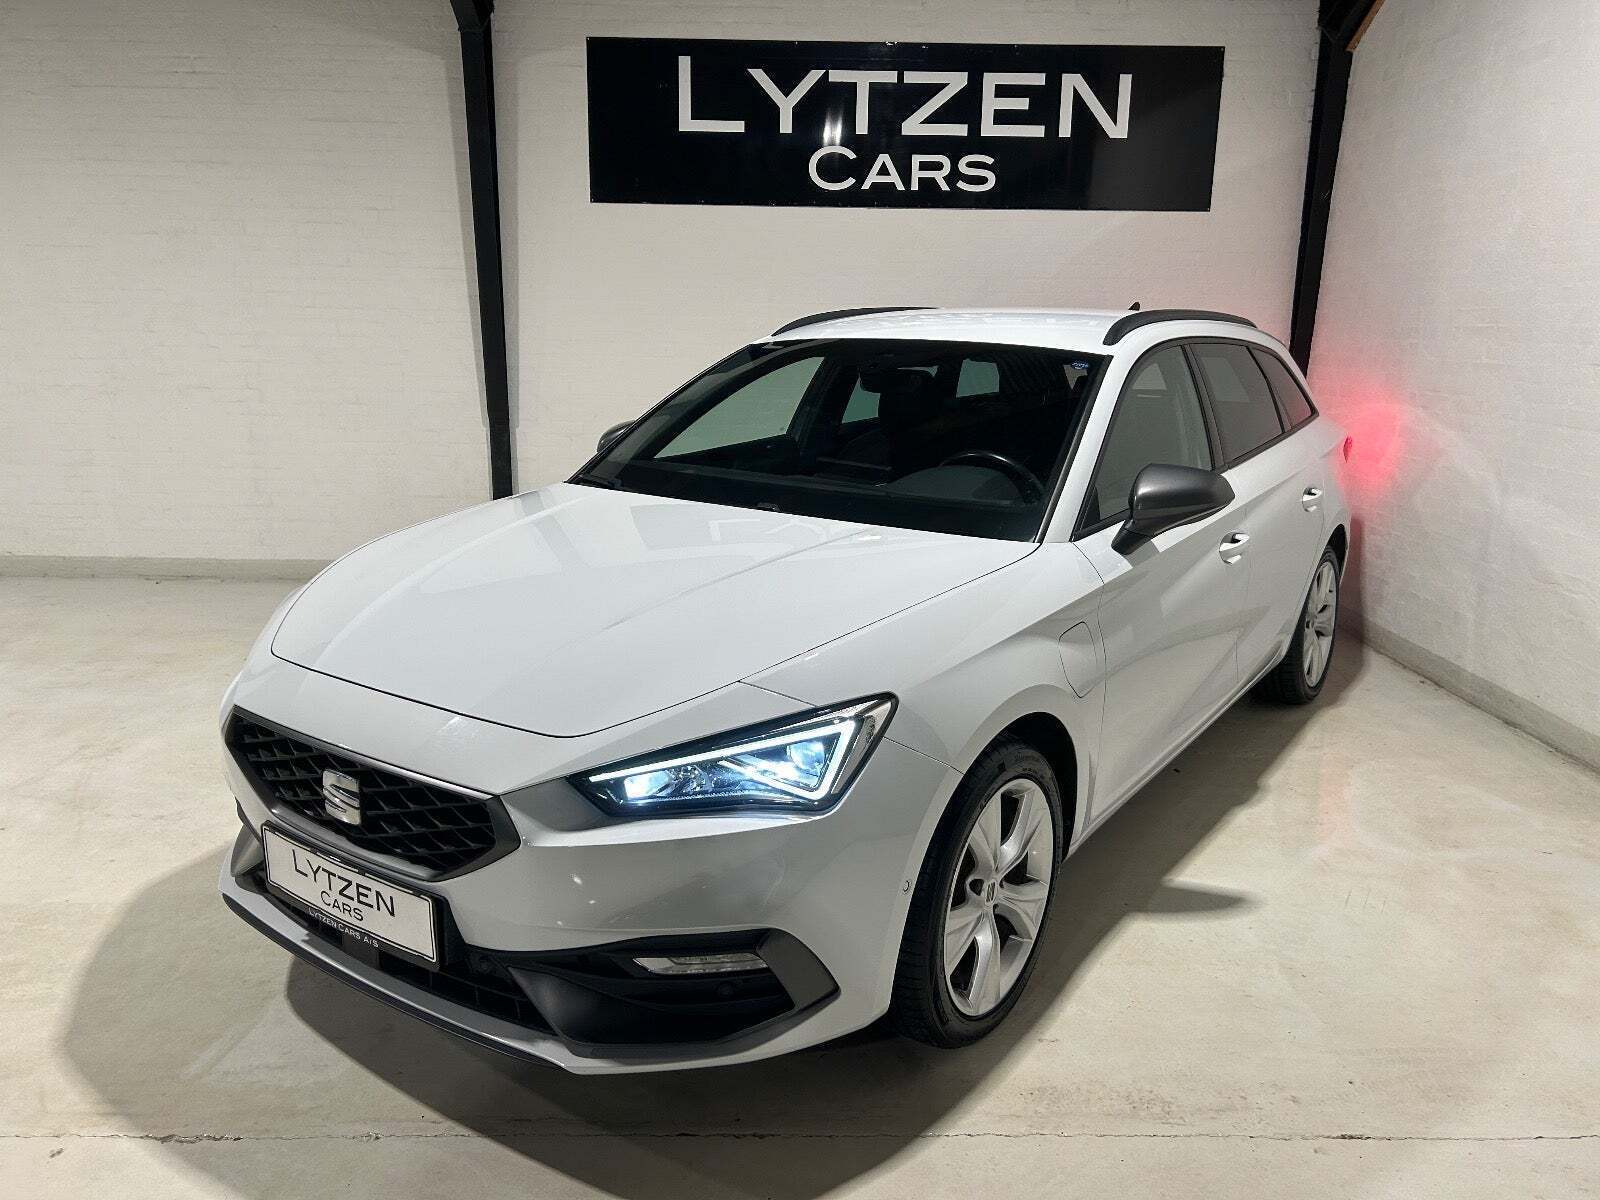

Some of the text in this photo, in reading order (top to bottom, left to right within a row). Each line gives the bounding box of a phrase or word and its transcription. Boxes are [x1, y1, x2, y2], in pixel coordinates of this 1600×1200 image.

[677, 55, 1132, 139] LYTZEN
[808, 145, 996, 192] CARS
[292, 849, 396, 917] LYTZEN
[320, 890, 364, 922] CARS
[308, 907, 337, 929] LYTZEN
